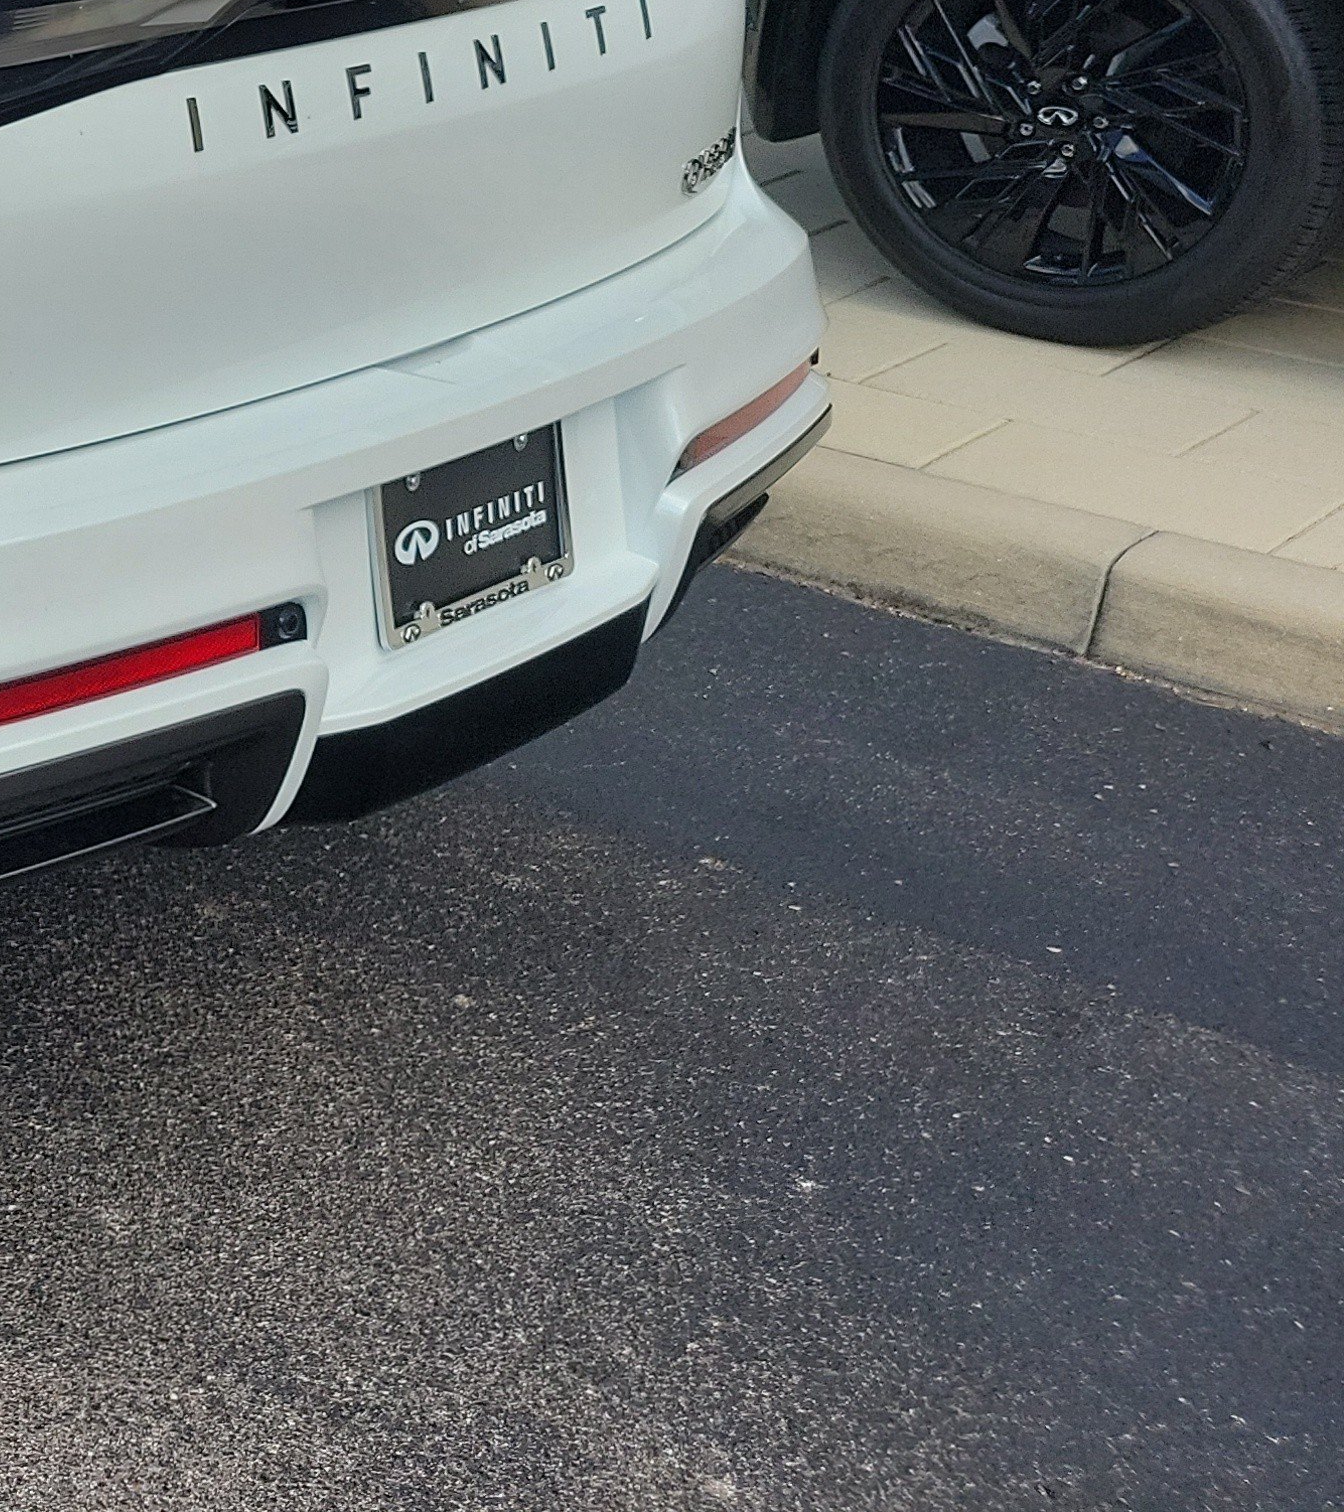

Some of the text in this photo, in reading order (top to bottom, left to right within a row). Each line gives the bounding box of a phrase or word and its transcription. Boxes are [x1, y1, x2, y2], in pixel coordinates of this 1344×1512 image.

[445, 480, 545, 542] INFINITI
[464, 509, 548, 556] of Sarasota
[439, 579, 531, 627] Sarasota
